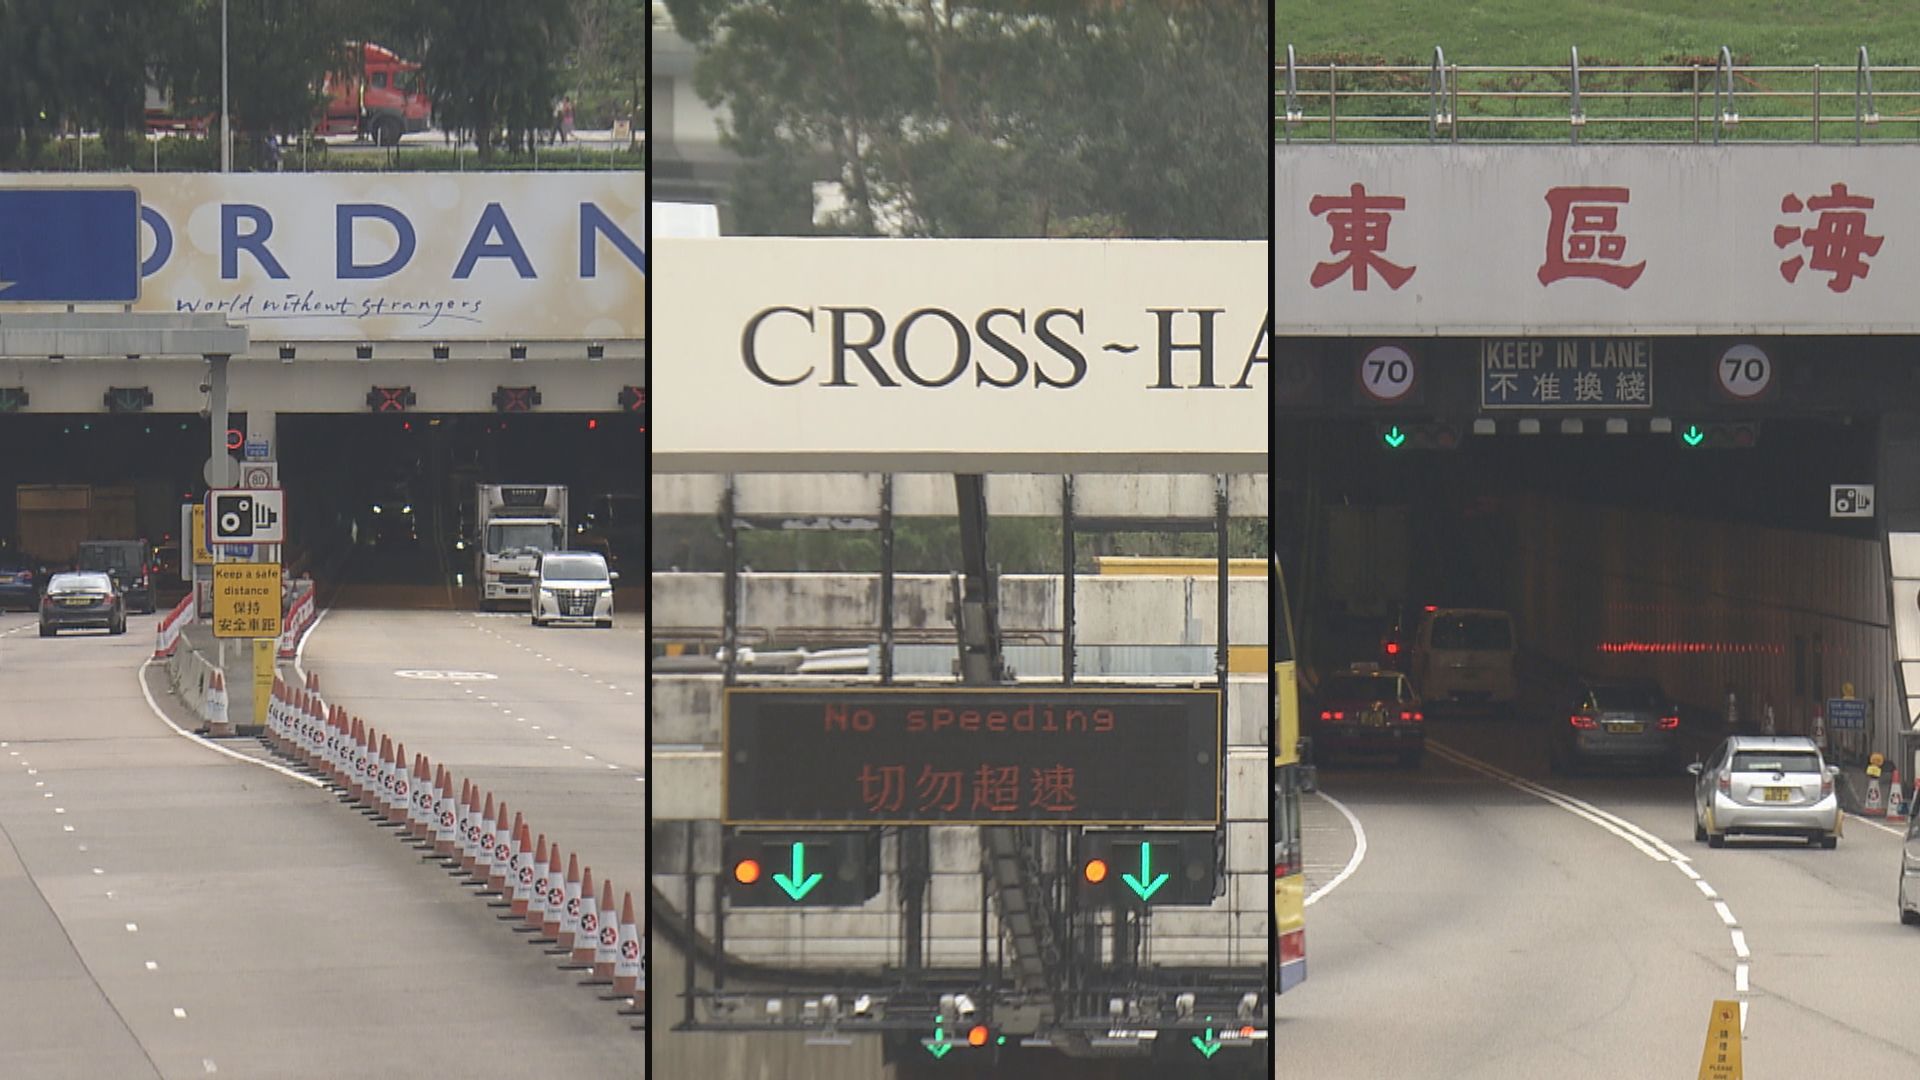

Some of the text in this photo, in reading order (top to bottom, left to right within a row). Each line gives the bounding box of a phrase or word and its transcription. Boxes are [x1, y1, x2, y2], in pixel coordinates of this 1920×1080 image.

[359, 297, 482, 329] strangers
[1487, 341, 1647, 369] KEEP IN LANE
[1369, 360, 1408, 385] 70
[1725, 358, 1765, 383] 70
[216, 568, 278, 580] Keep a safe
[224, 586, 269, 596] distance
[233, 602, 261, 615] 保持
[218, 618, 276, 632] 安全車距
[824, 704, 1115, 732] No speeding
[856, 763, 1079, 813] 切勿超速
